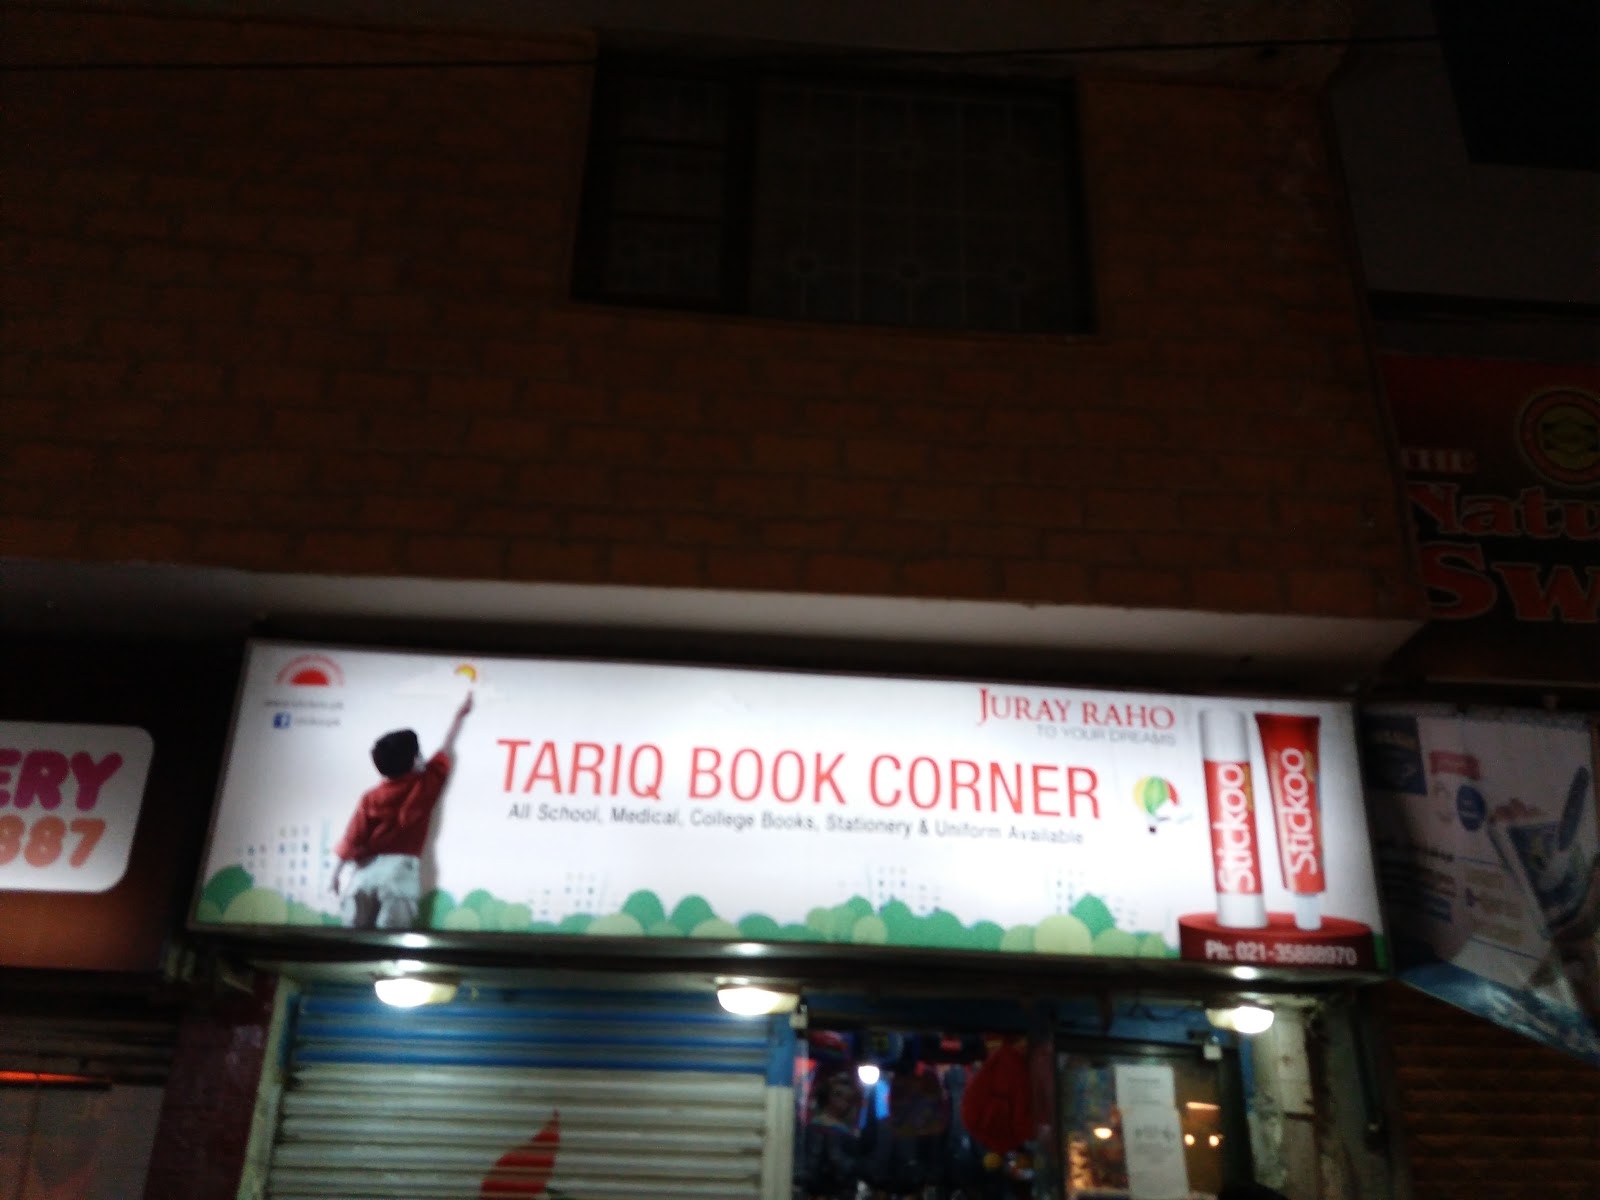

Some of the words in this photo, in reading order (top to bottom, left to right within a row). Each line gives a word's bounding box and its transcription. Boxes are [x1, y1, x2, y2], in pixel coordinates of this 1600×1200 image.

[976, 687, 1071, 726] JURAY
[1081, 700, 1175, 730] RAHO
[496, 738, 664, 801] TARIQ
[688, 747, 847, 805] BOOK
[869, 754, 1101, 819] CORNER
[1281, 747, 1318, 877] Stickoo
[826, 814, 912, 839] Stationery
[1211, 762, 1257, 892] Stickoo
